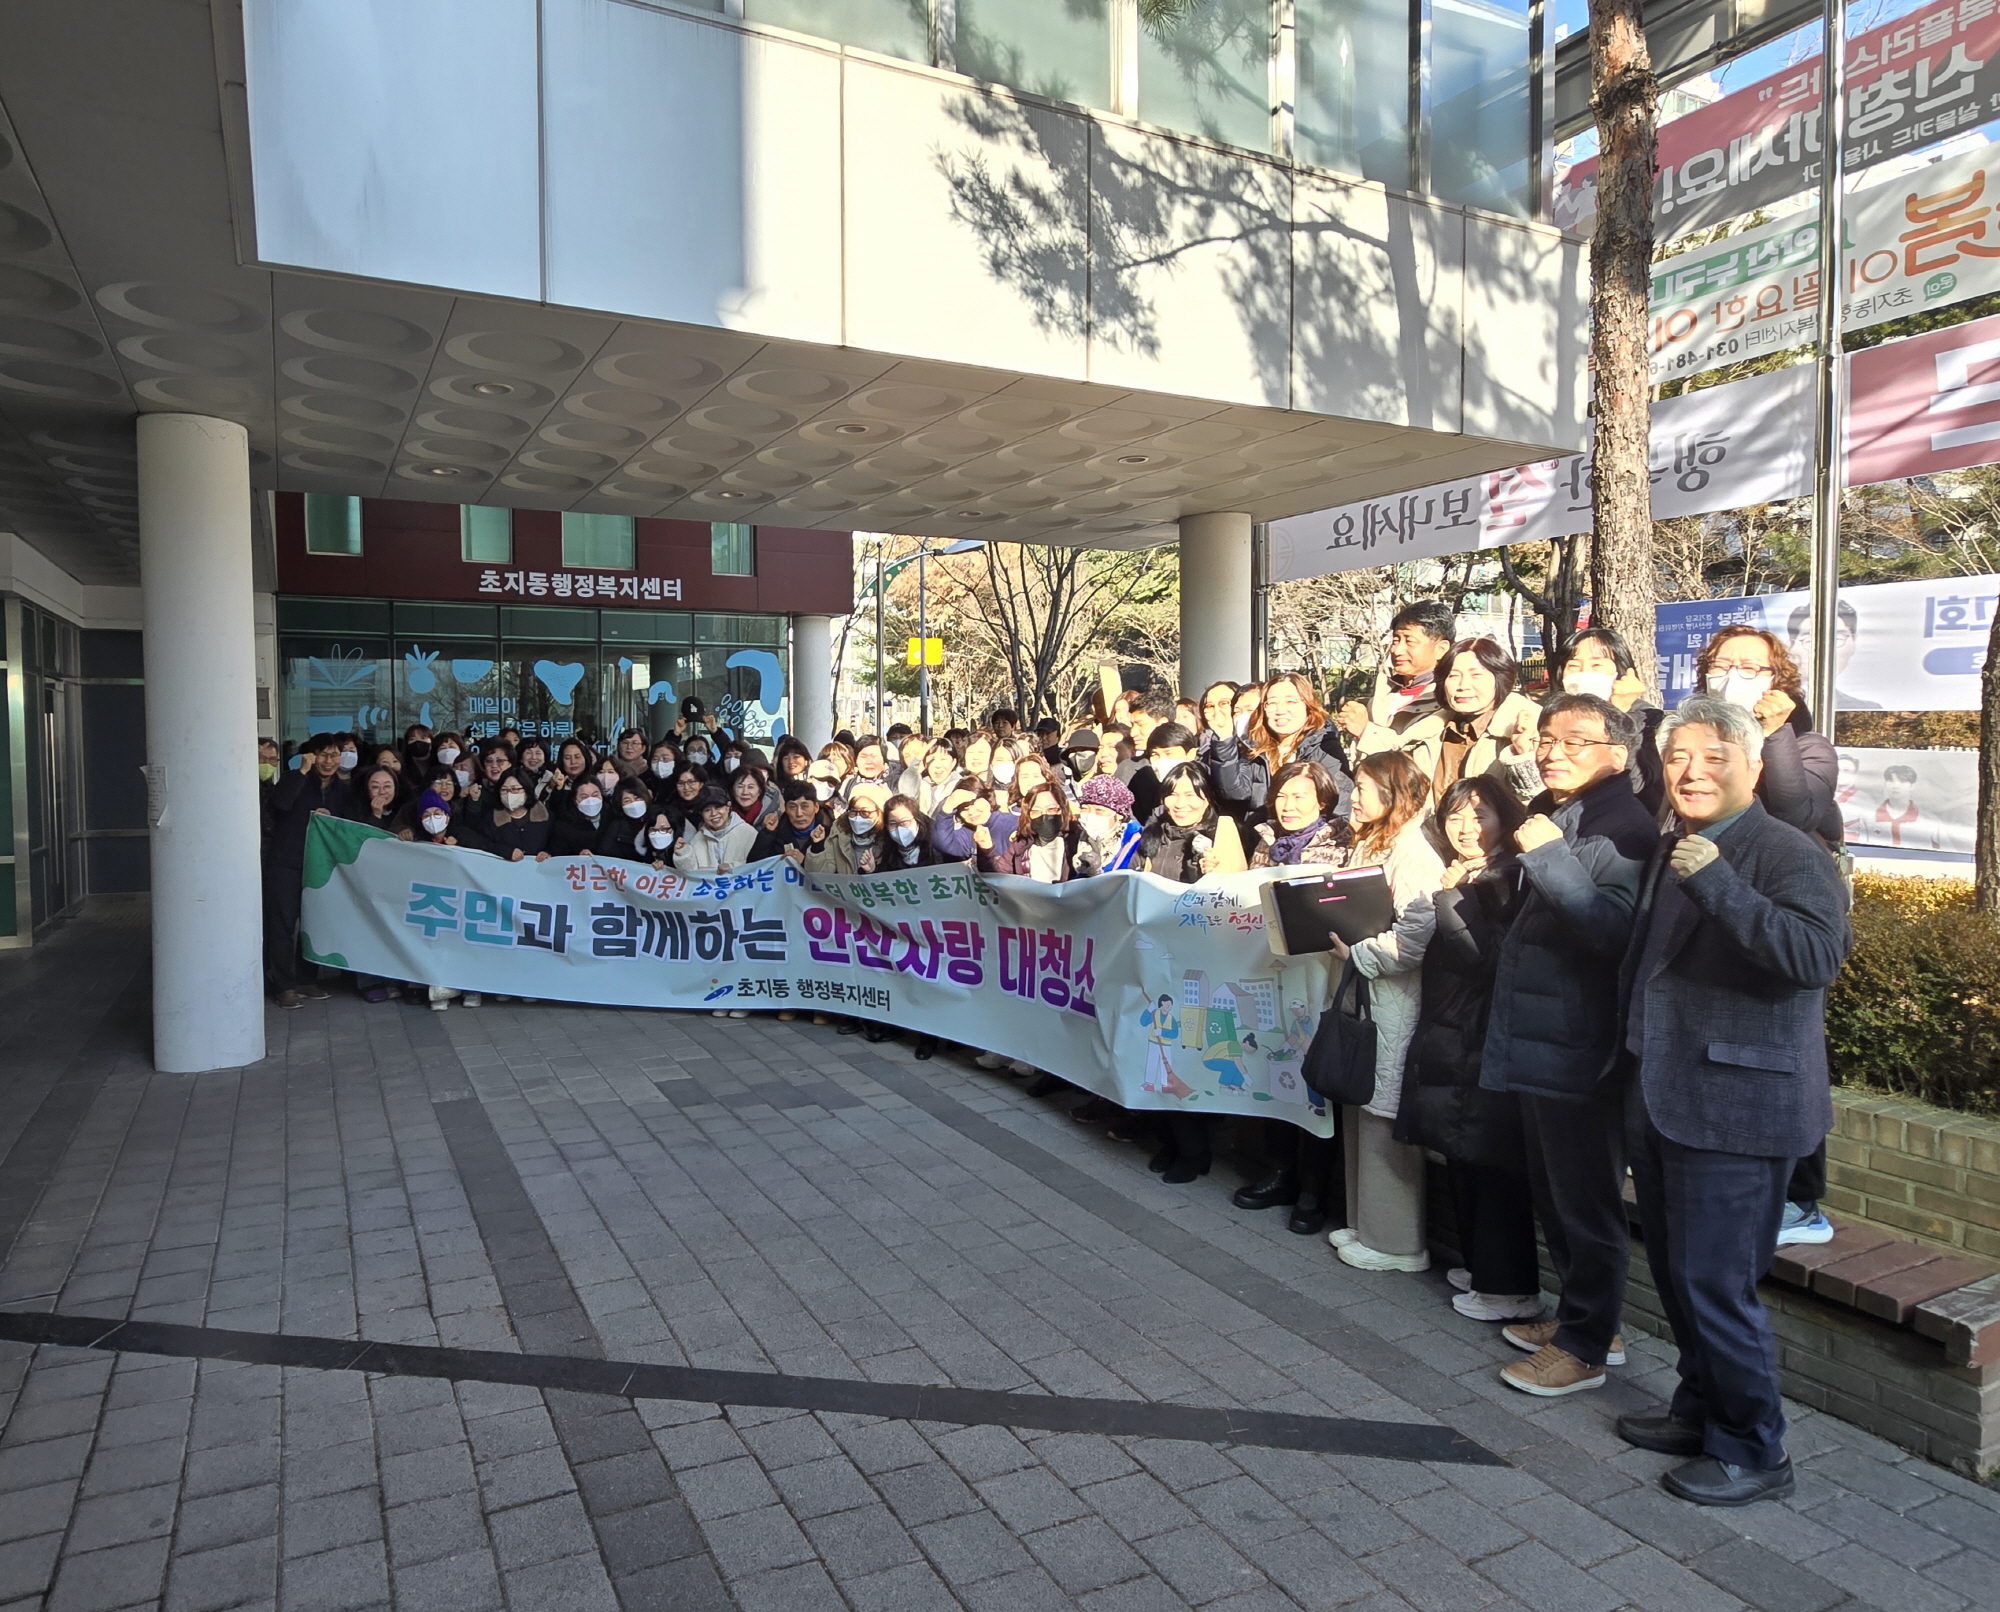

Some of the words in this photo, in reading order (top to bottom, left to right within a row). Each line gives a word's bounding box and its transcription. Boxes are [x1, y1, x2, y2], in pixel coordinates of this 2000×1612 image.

[479, 570, 683, 601] 초지동행정복지센터
[469, 697, 516, 714] 매일이
[470, 721, 500, 738] 선물
[566, 863, 628, 894] 친근한
[635, 866, 687, 899] 이웃!
[692, 869, 774, 901] 소통하는
[825, 883, 847, 901] 더
[848, 878, 921, 908] 행복한
[405, 883, 571, 954] 주민과
[591, 901, 788, 962] 함께하는
[802, 906, 984, 987] 안산사랑
[999, 926, 1098, 1020] 대청소
[737, 978, 790, 1000] 초지동
[796, 979, 891, 1012] 행정복지센터
